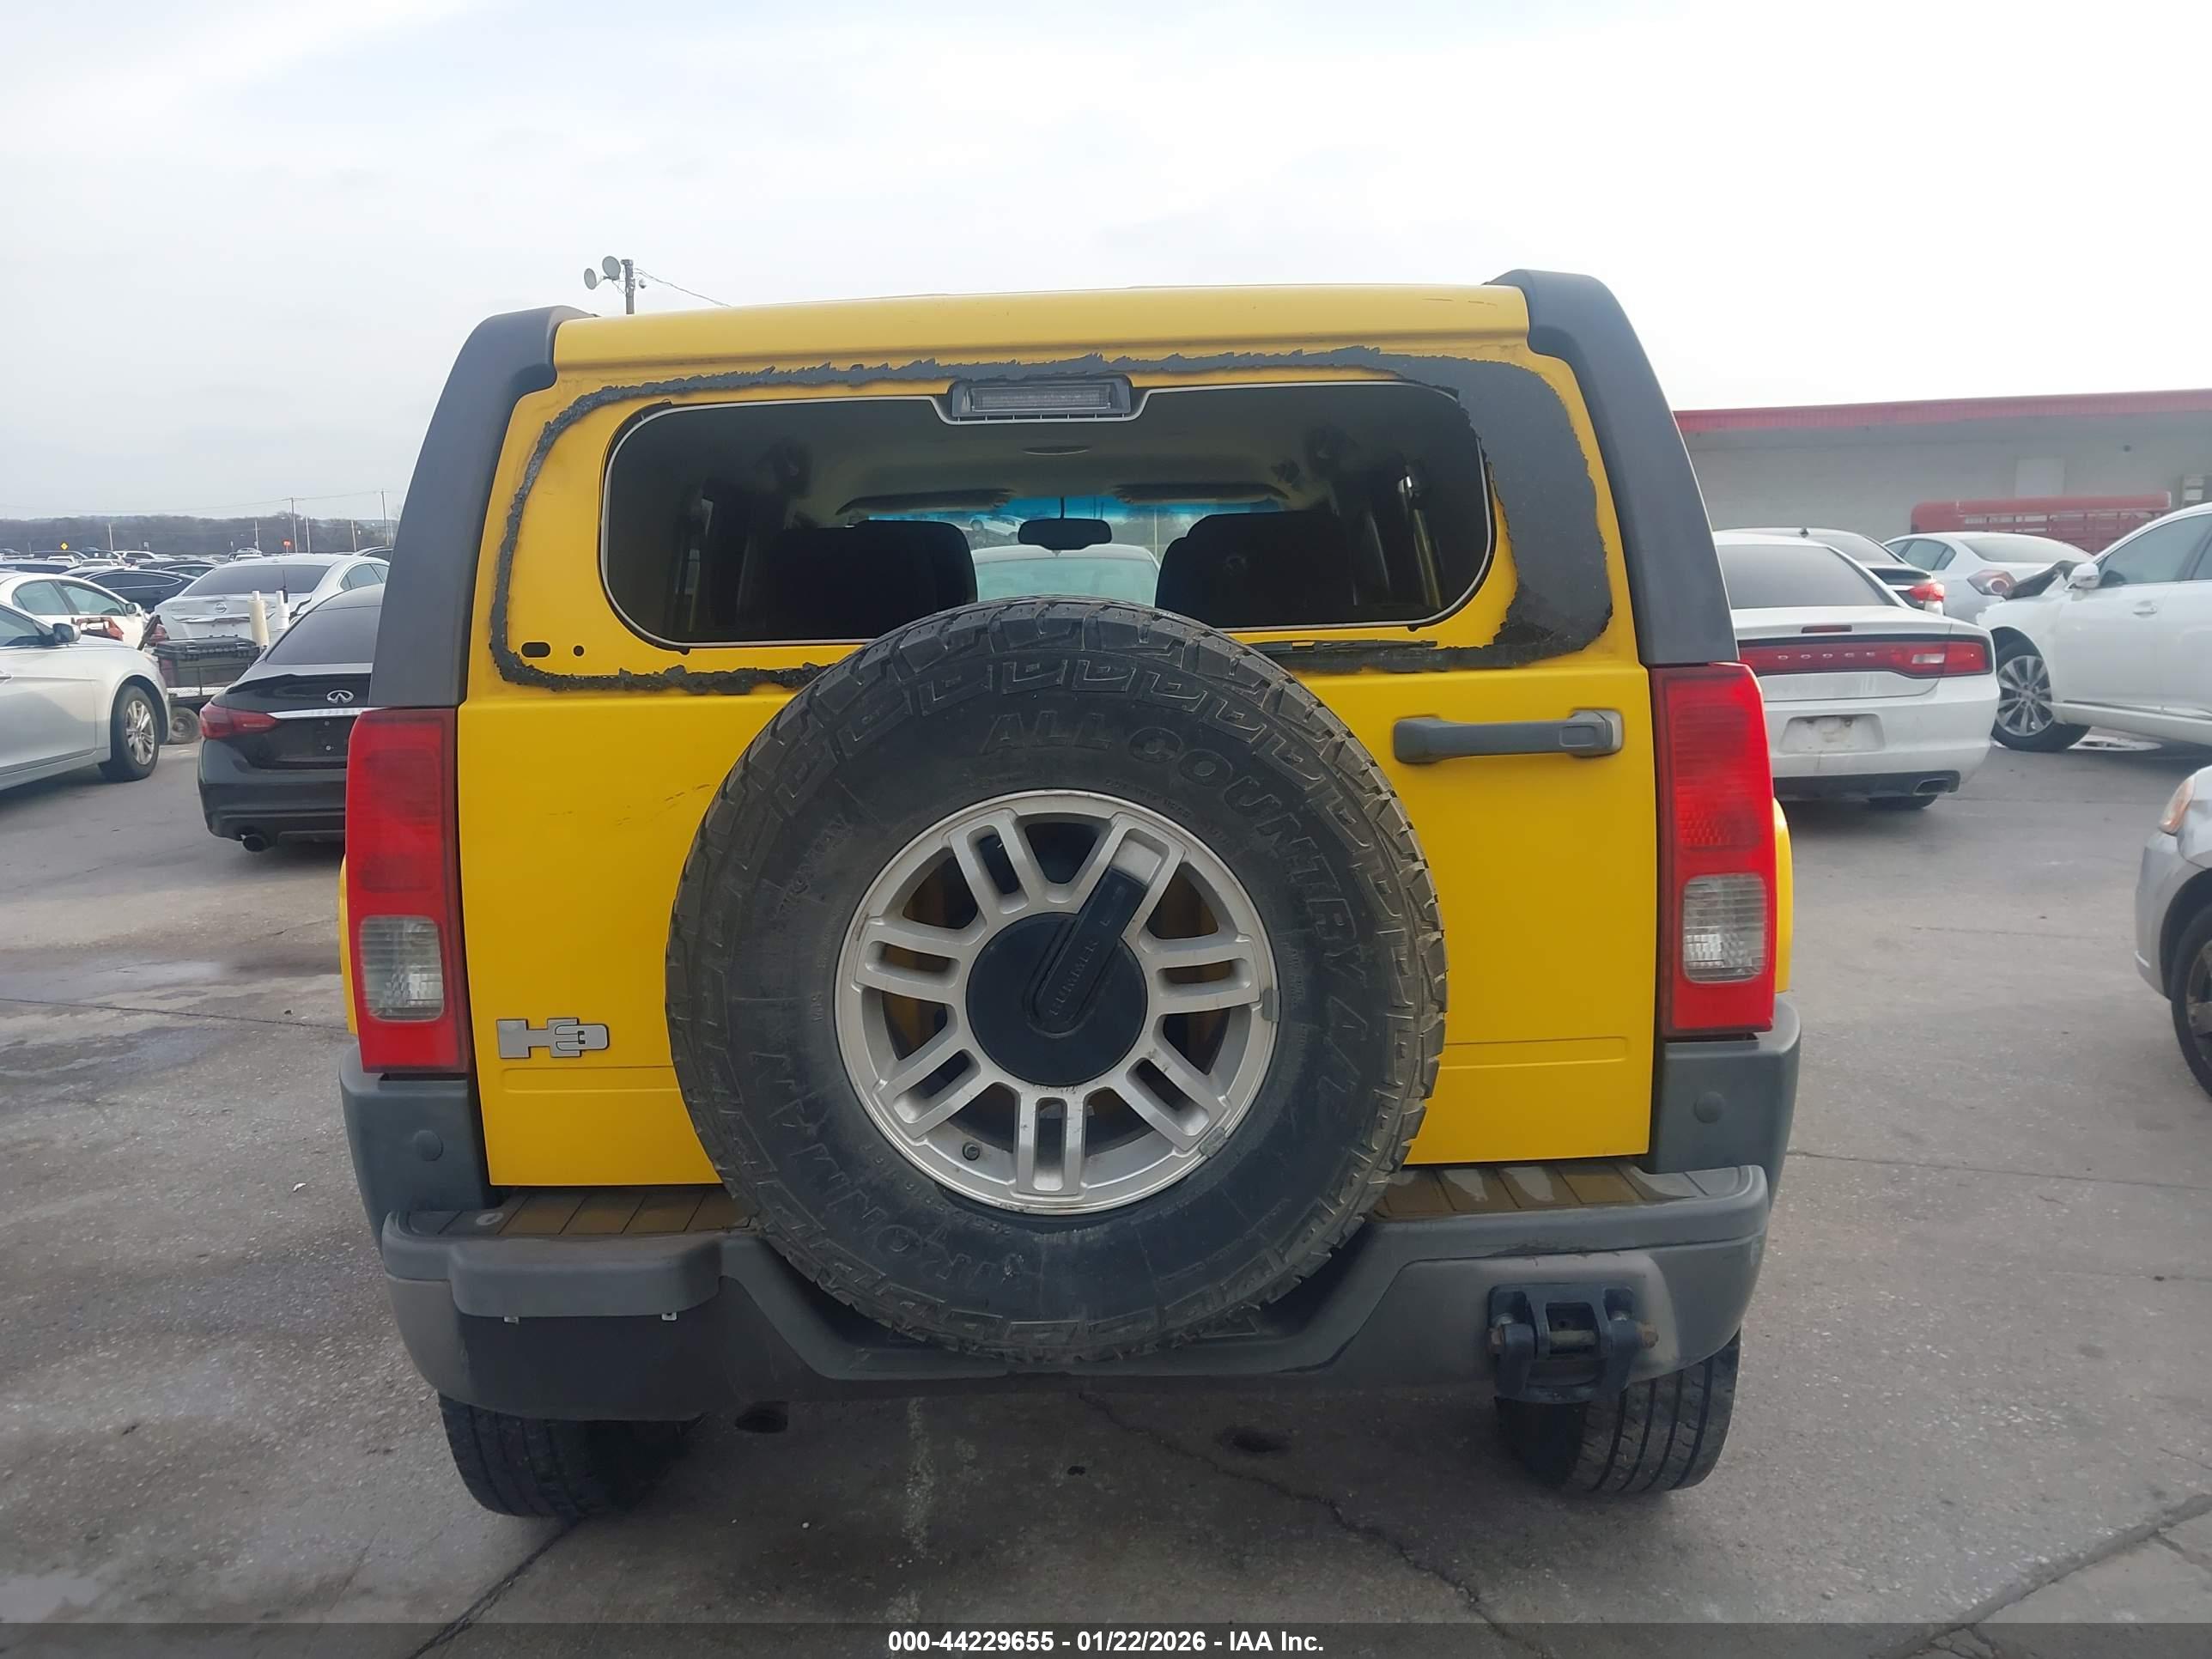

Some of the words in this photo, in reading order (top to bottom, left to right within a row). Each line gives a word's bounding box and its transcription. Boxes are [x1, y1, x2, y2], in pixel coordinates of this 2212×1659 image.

[977, 710, 1114, 756] ALL
[1128, 726, 1367, 984] COUNTRY
[496, 1018, 610, 1059] H3
